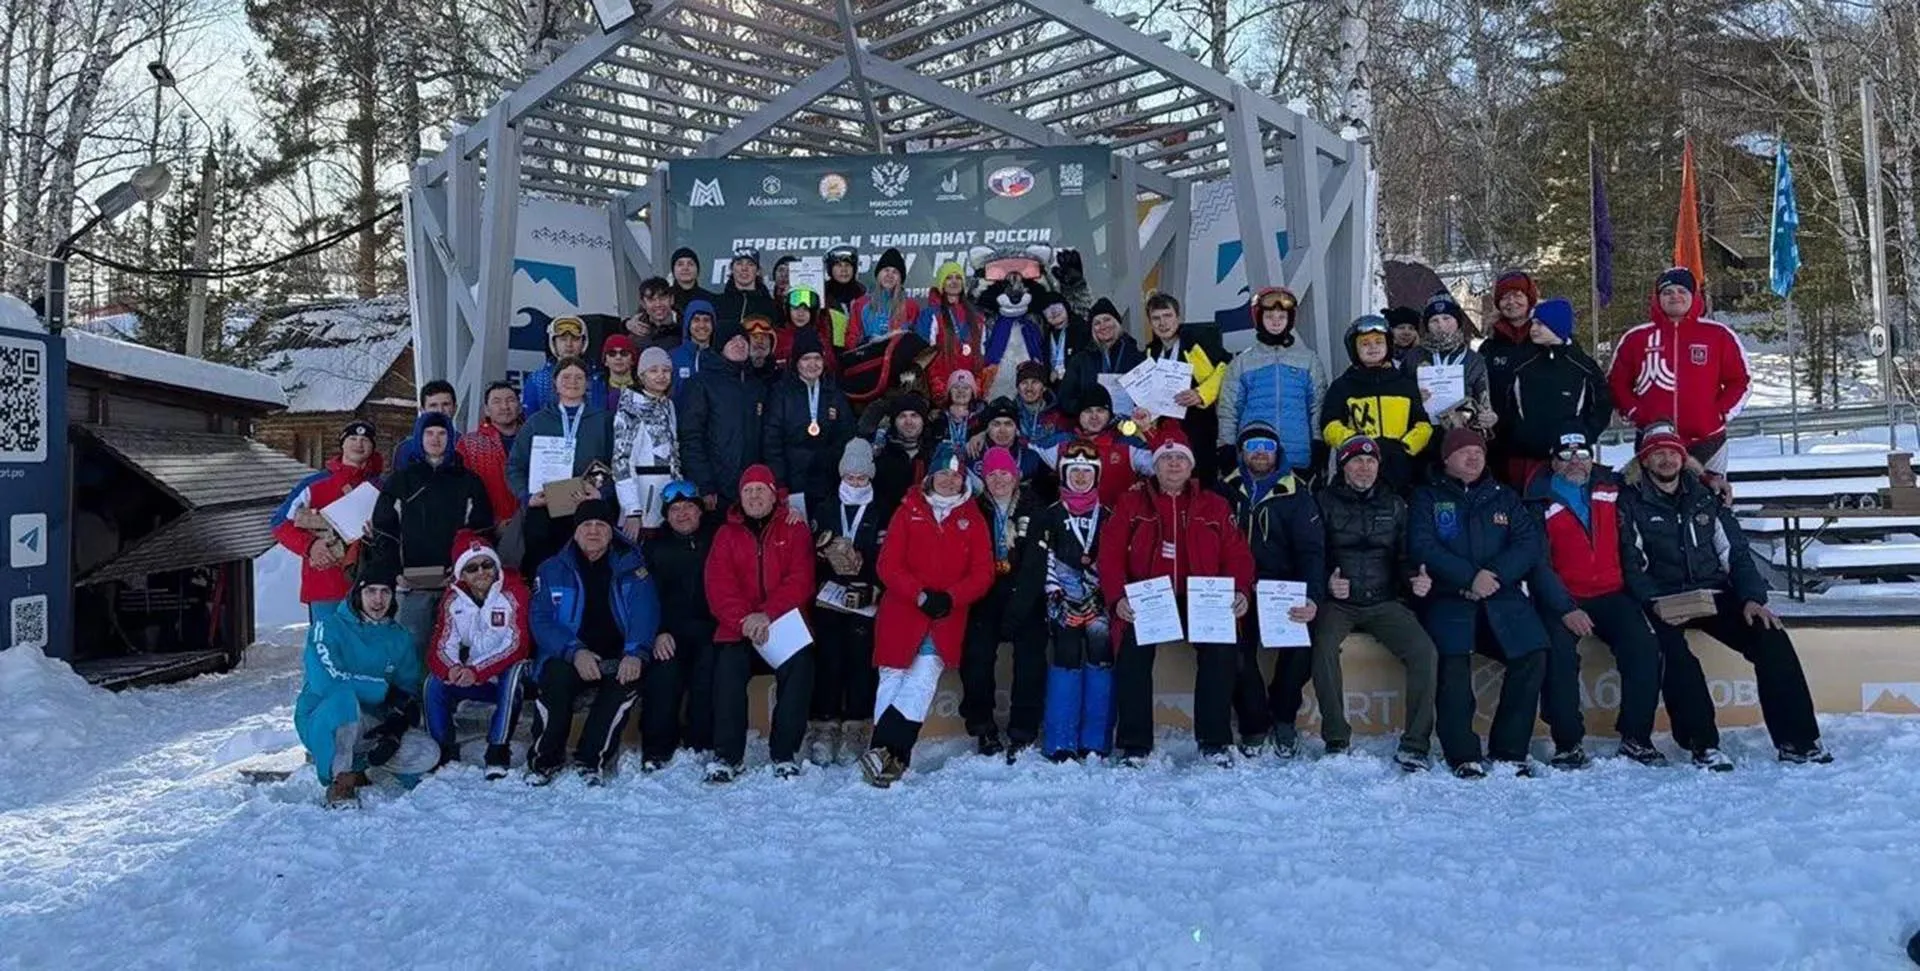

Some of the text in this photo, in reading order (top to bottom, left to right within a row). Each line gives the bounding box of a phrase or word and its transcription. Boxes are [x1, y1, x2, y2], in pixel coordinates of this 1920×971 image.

[747, 196, 798, 208] Абзаково
[869, 199, 913, 208] МИНСПОРТ
[875, 209, 909, 217] РОССИИ
[731, 235, 842, 252] ПЕРВЕНСТВО
[869, 231, 977, 247] ЧЕМПИОНАТ
[983, 228, 1051, 244] РОССИИ
